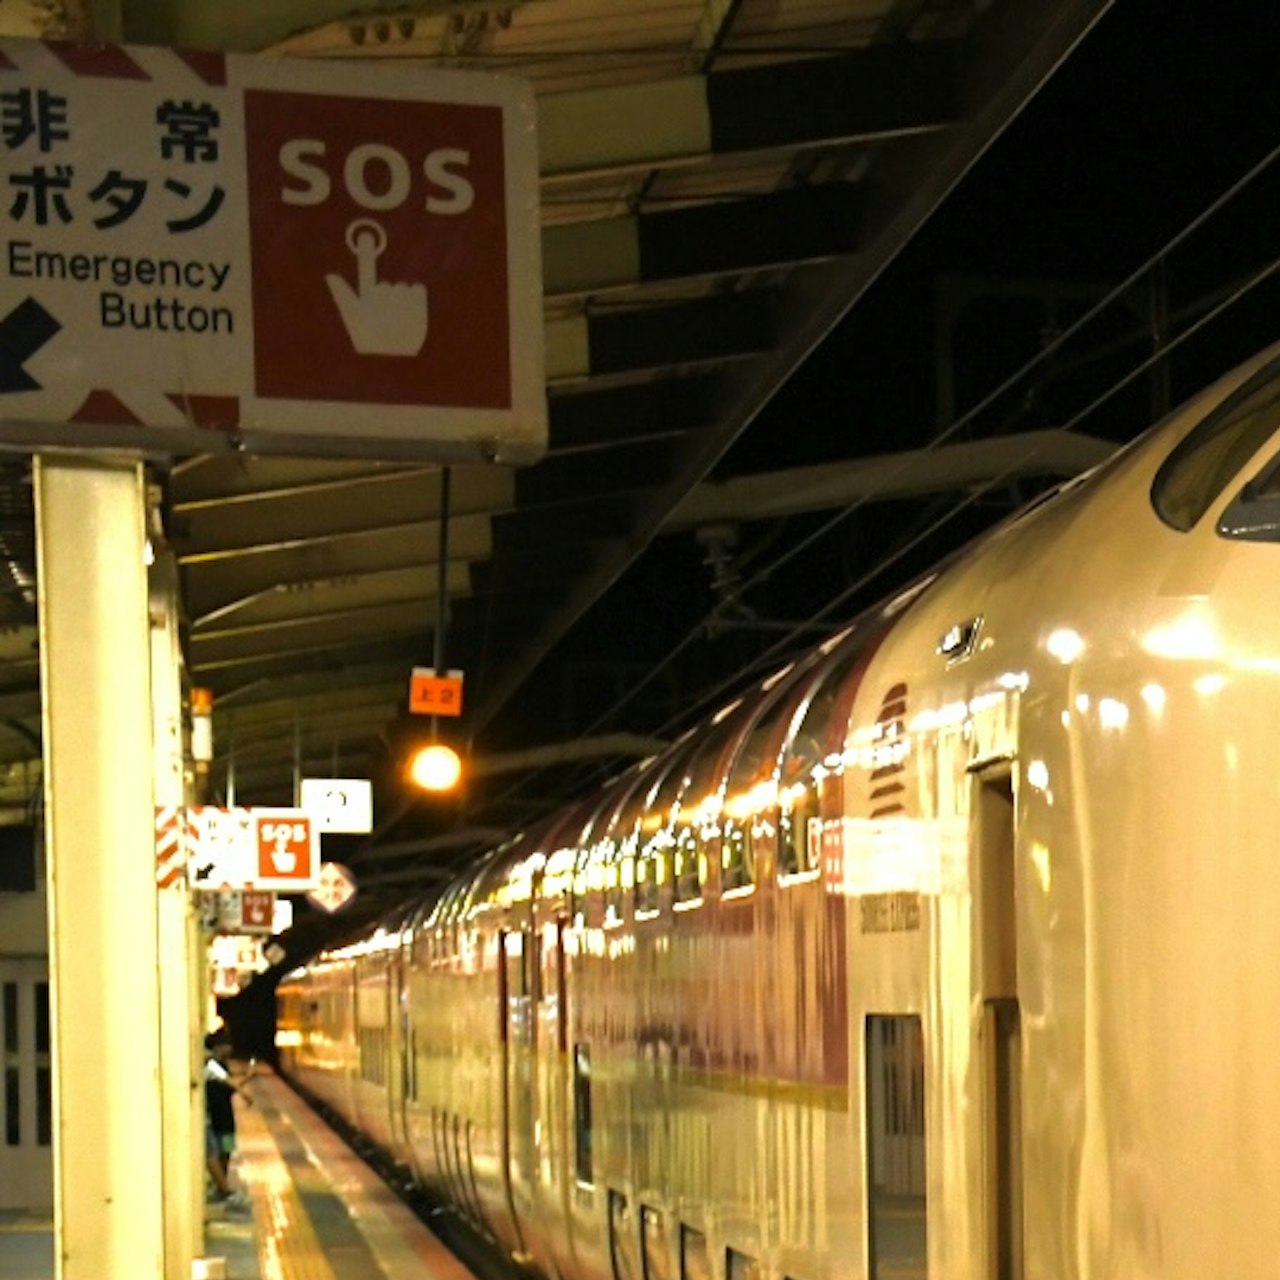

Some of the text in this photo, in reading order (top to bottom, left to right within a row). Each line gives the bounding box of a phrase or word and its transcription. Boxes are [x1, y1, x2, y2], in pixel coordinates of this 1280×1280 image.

[0, 87, 220, 164] 非常
[8, 165, 226, 234] ボタン
[279, 138, 475, 216] SOS
[8, 240, 230, 291] Emergency
[100, 291, 234, 334] Button
[261, 823, 306, 843] SOS
